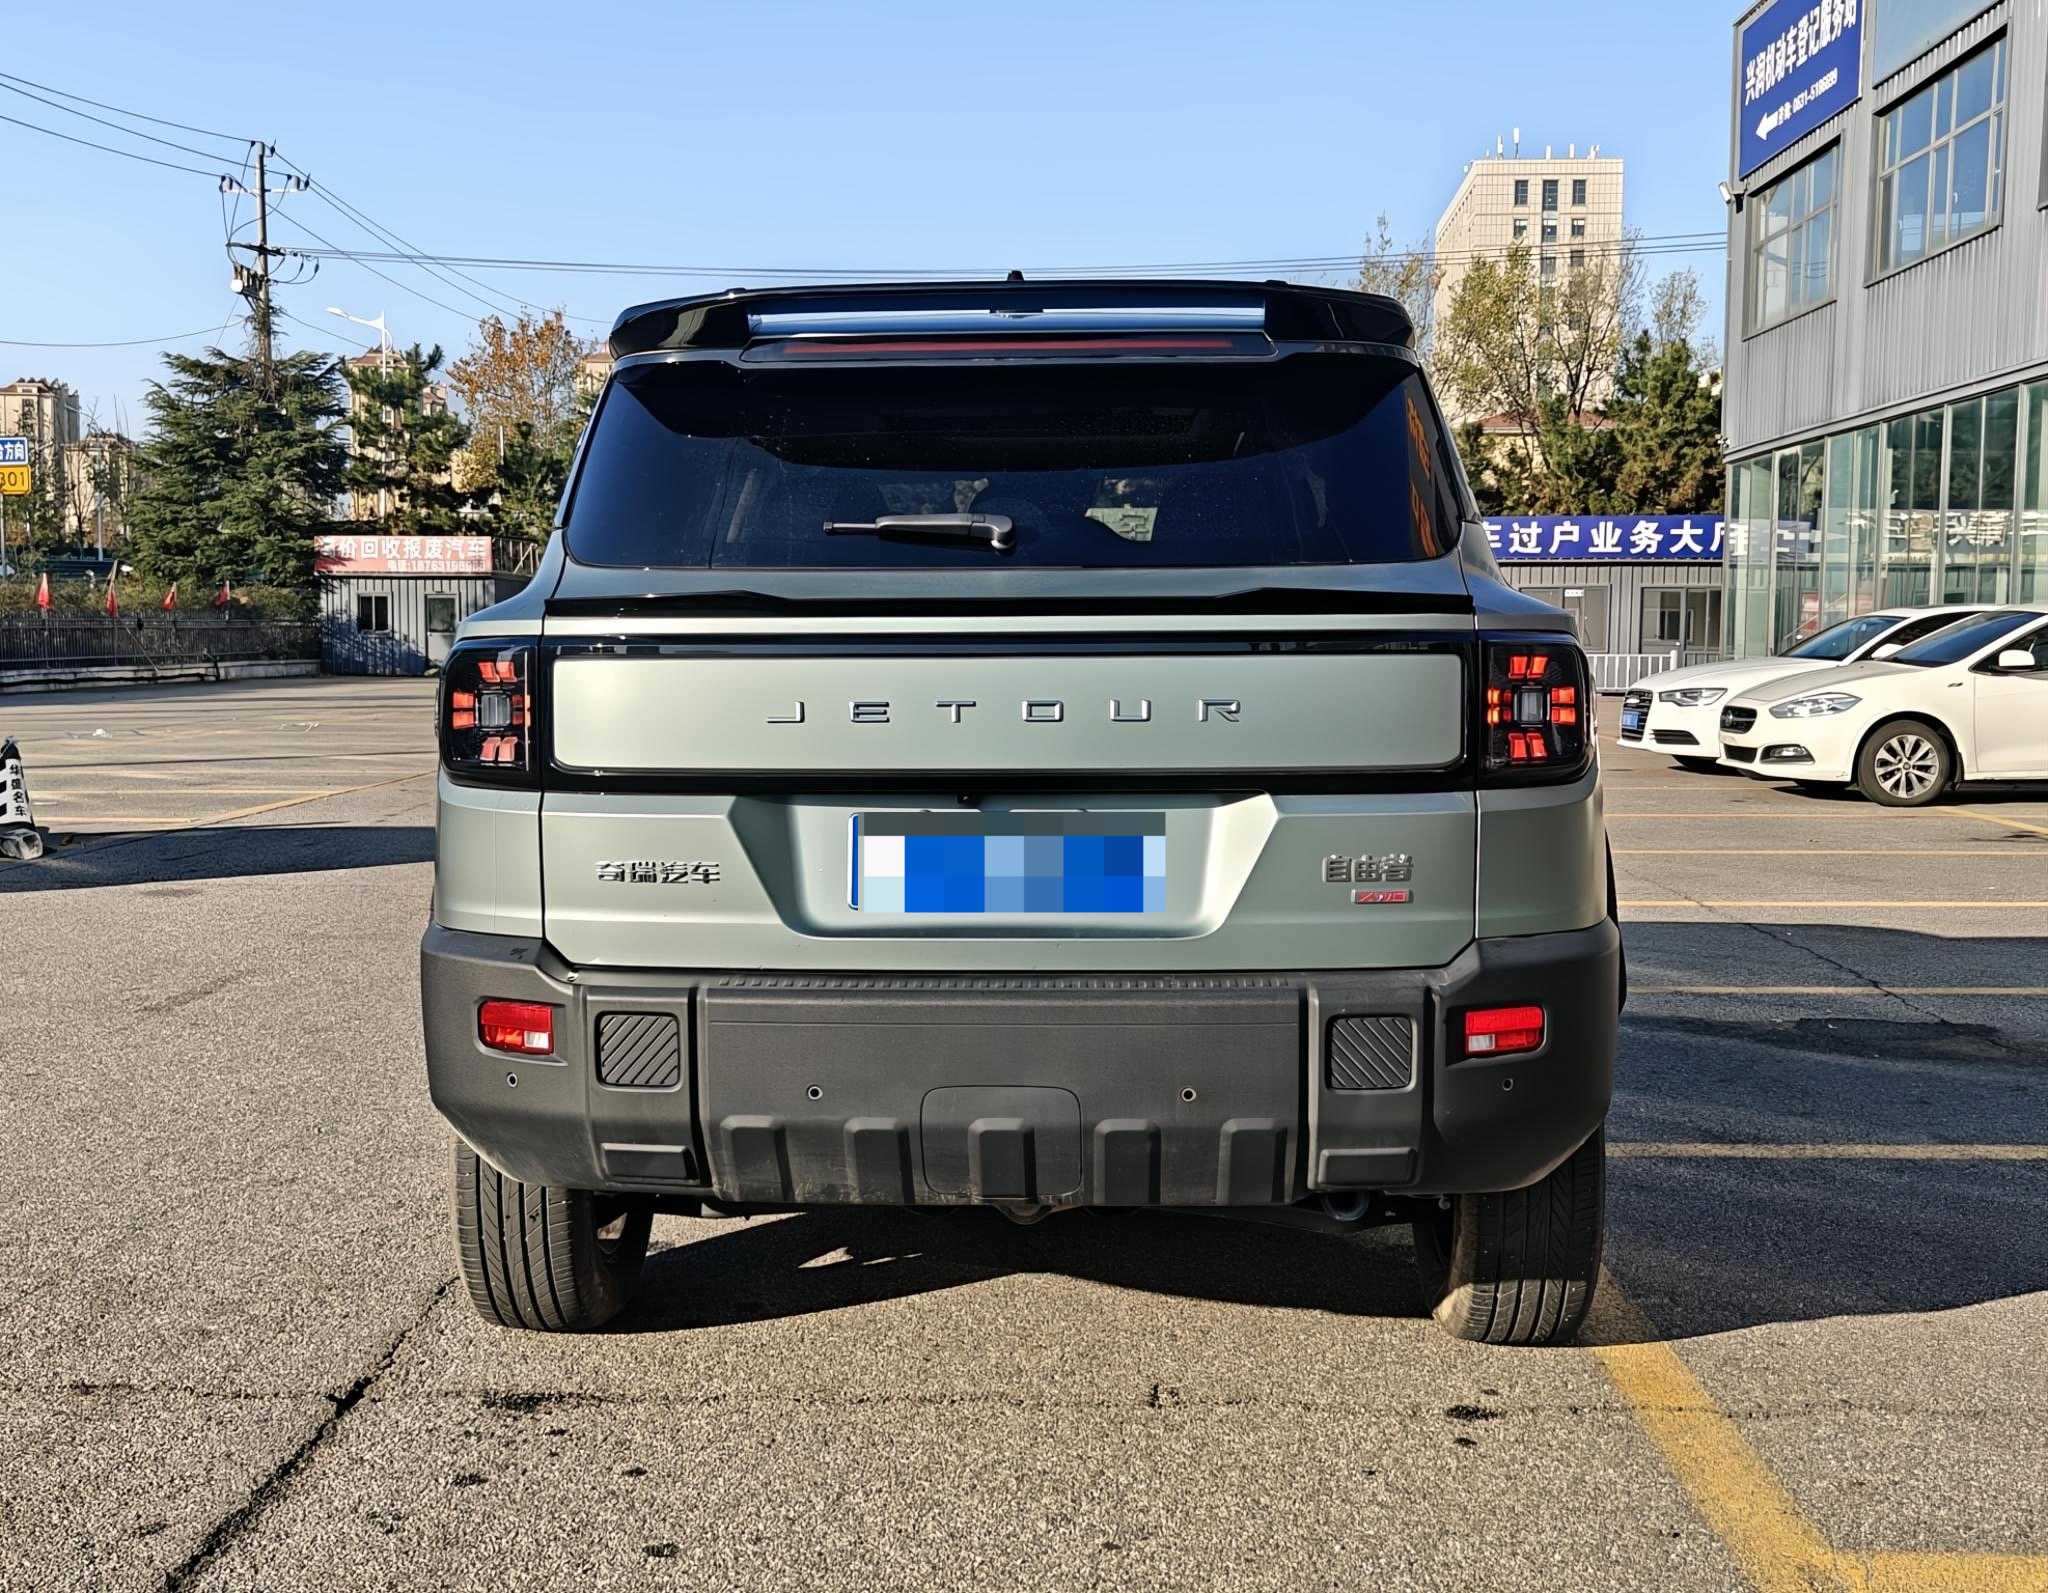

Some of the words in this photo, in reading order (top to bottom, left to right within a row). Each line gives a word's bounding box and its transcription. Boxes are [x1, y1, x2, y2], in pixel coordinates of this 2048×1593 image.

[765, 699, 1240, 723] JETOUR
[594, 860, 721, 884] 奇瑞汽车
[1322, 853, 1414, 882] 自由者
